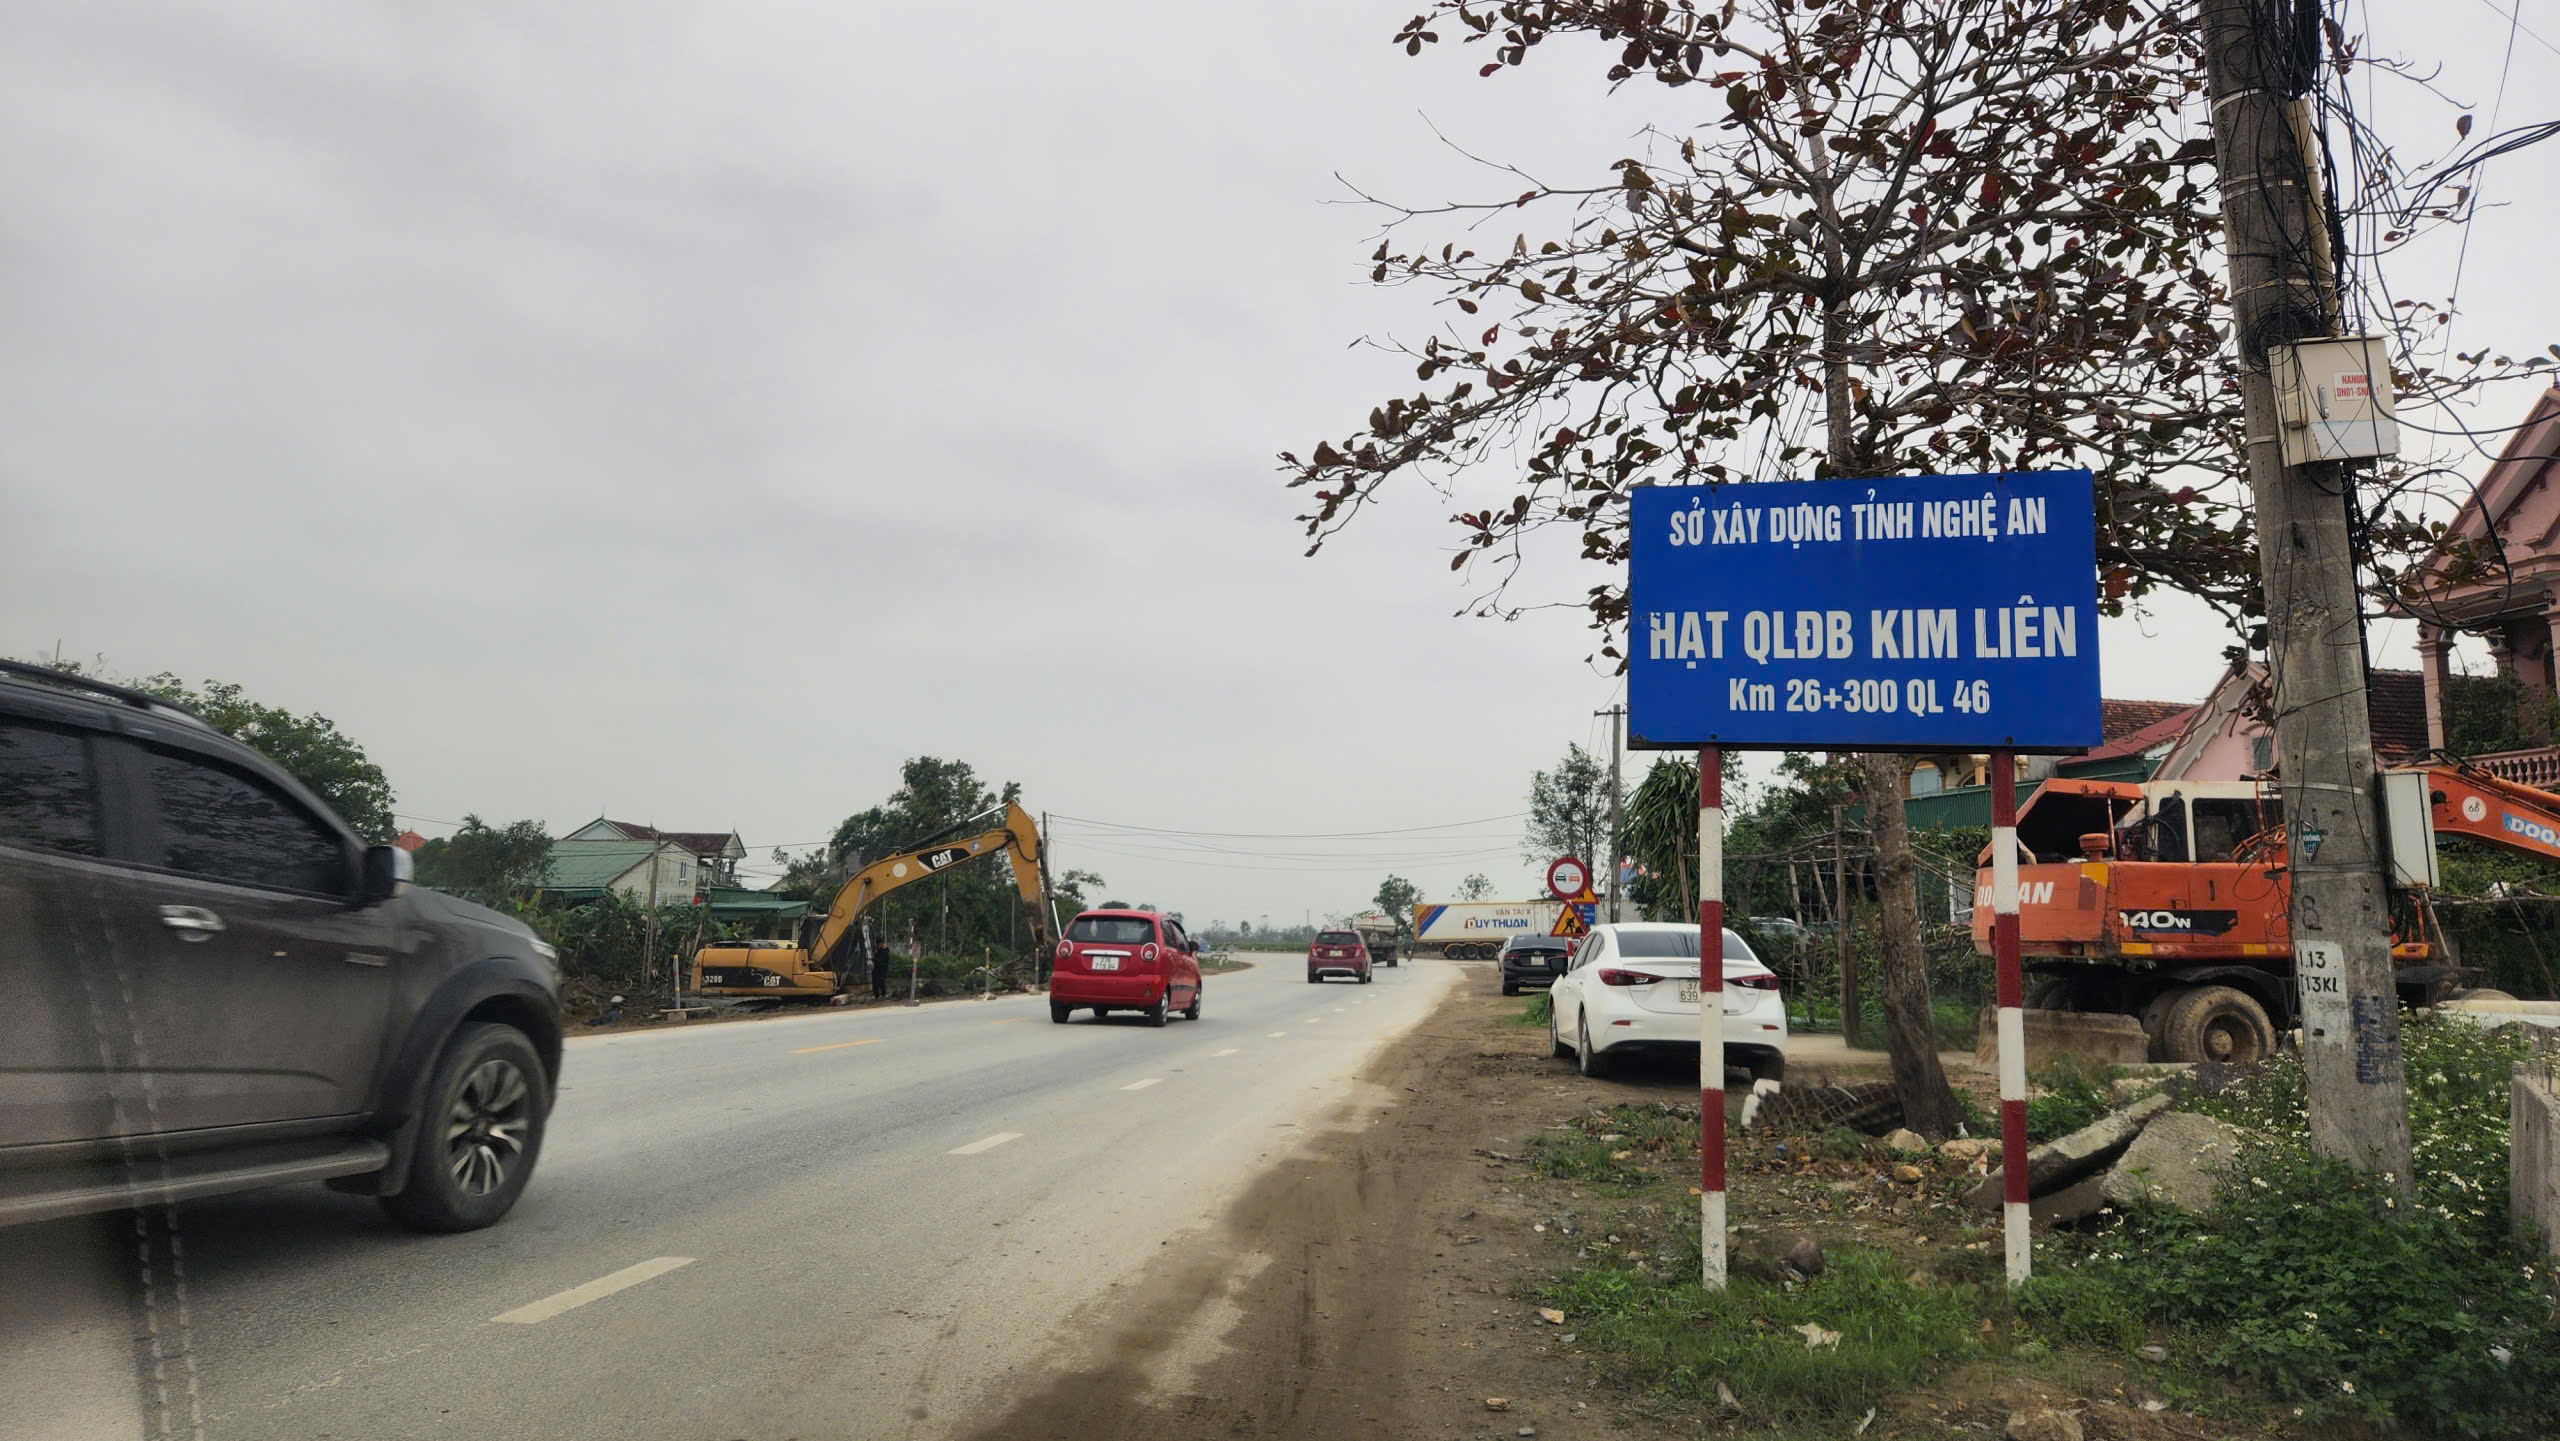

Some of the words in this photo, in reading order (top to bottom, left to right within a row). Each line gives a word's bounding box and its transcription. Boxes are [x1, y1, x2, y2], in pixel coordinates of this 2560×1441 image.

[1670, 497, 1705, 545] SỞ
[1712, 502, 1761, 544] XÂY
[1770, 503, 1841, 548] DỰNG
[1852, 489, 1913, 540] TỈNH
[1923, 492, 1997, 542] NGHỆ
[2007, 498, 2046, 535] AN
[1651, 612, 1728, 668] HẠT
[1744, 611, 1853, 664] QLĐB
[1872, 609, 1957, 658] KIM
[1975, 595, 2076, 657] LIÊN
[1730, 679, 1774, 710] Km
[1787, 679, 1897, 712] 26+300
[1907, 679, 1943, 716] QL
[1953, 680, 1989, 713] 46
[2510, 817, 2560, 848] DOO
[931, 849, 953, 868] CAT
[1976, 881, 2055, 907] DOAN
[763, 975, 781, 986] CAT
[1680, 990, 1698, 1001] 639
